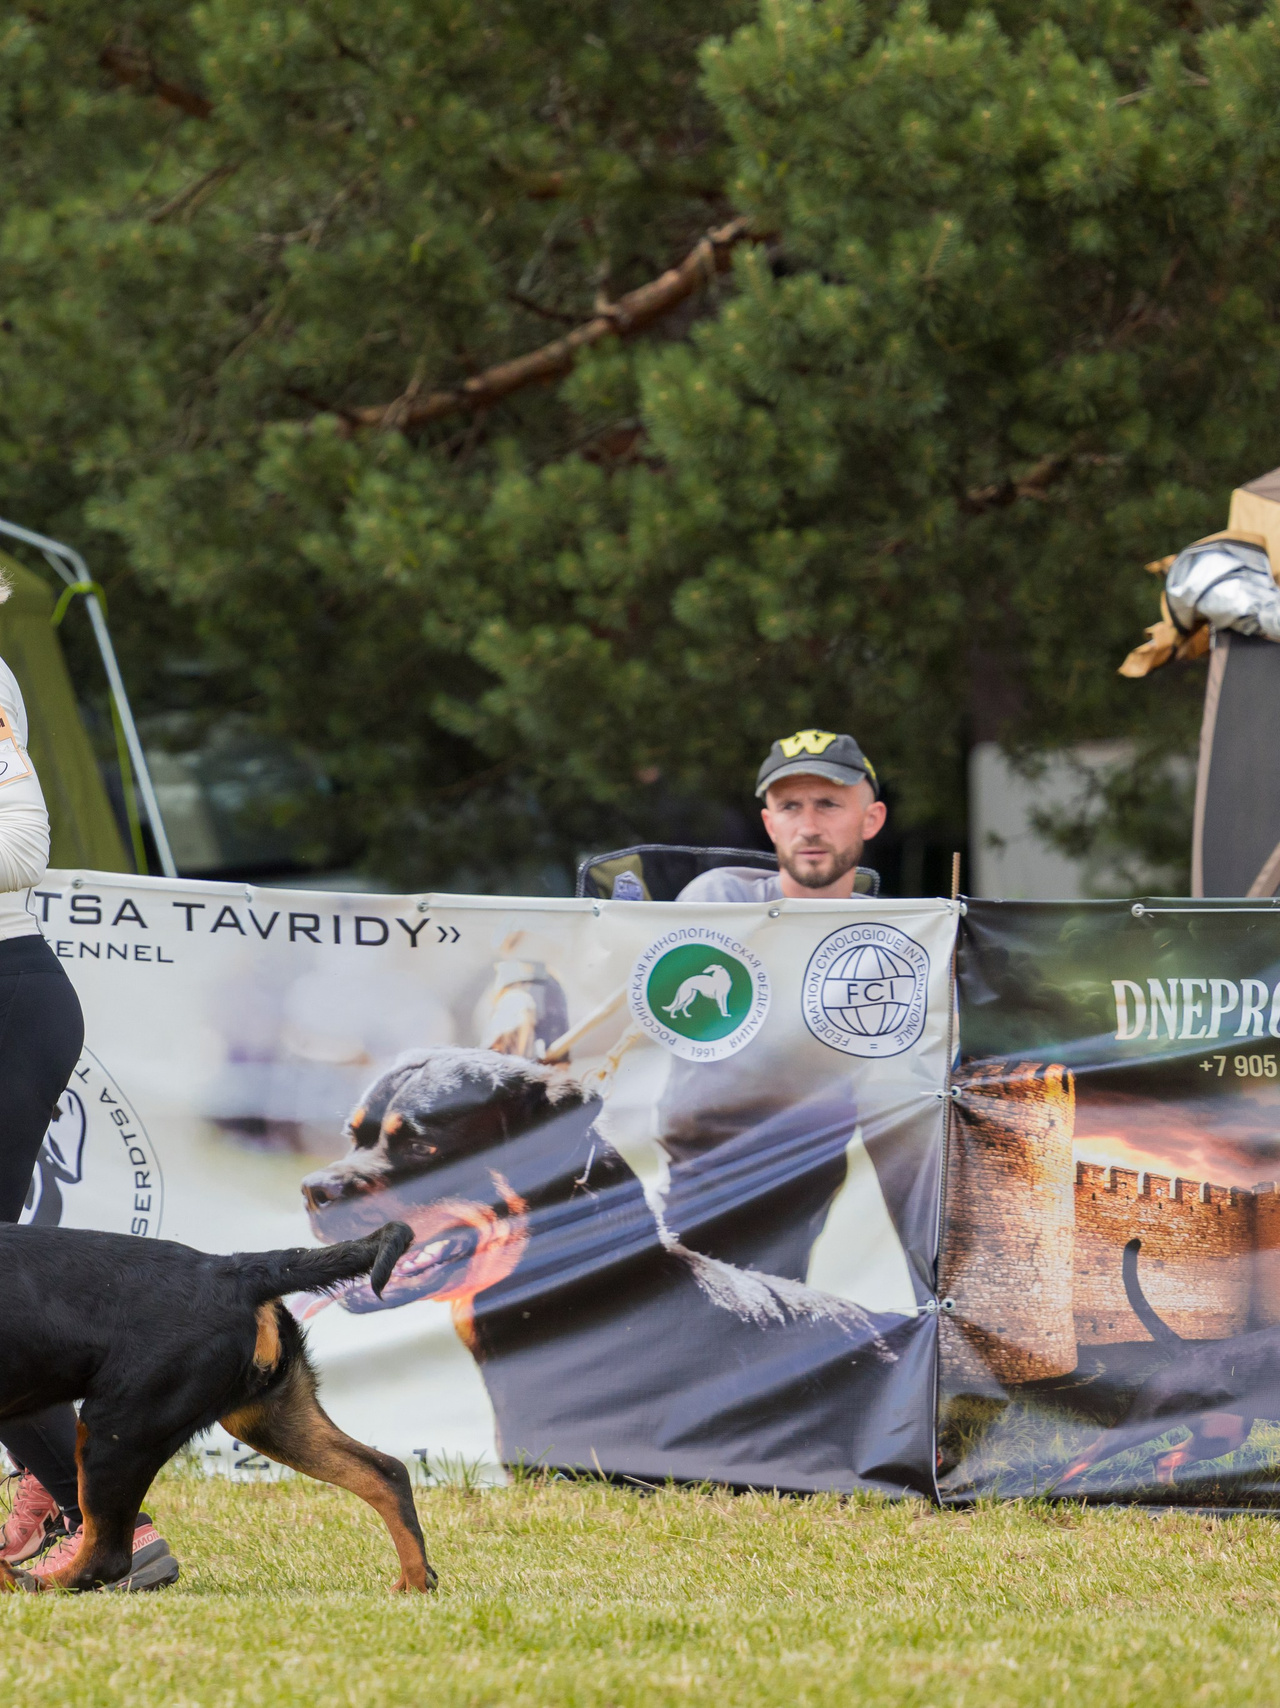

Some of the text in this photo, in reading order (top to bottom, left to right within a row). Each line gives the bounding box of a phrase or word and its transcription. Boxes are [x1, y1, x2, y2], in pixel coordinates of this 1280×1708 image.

[780, 729, 837, 758] W
[46, 939, 174, 964] ENNEL
[632, 927, 769, 1049] РОССИЙСКАЯ КИНОЛОГИЧЕСКАЯ ФЕДЕРАЦИЯ
[815, 929, 904, 970] CYNOLOGIQUE
[894, 945, 927, 1047] INTERNATIONALE
[847, 980, 894, 1005] FCI
[690, 1046, 716, 1059] 1991
[1199, 1054, 1278, 1078] +7 905
